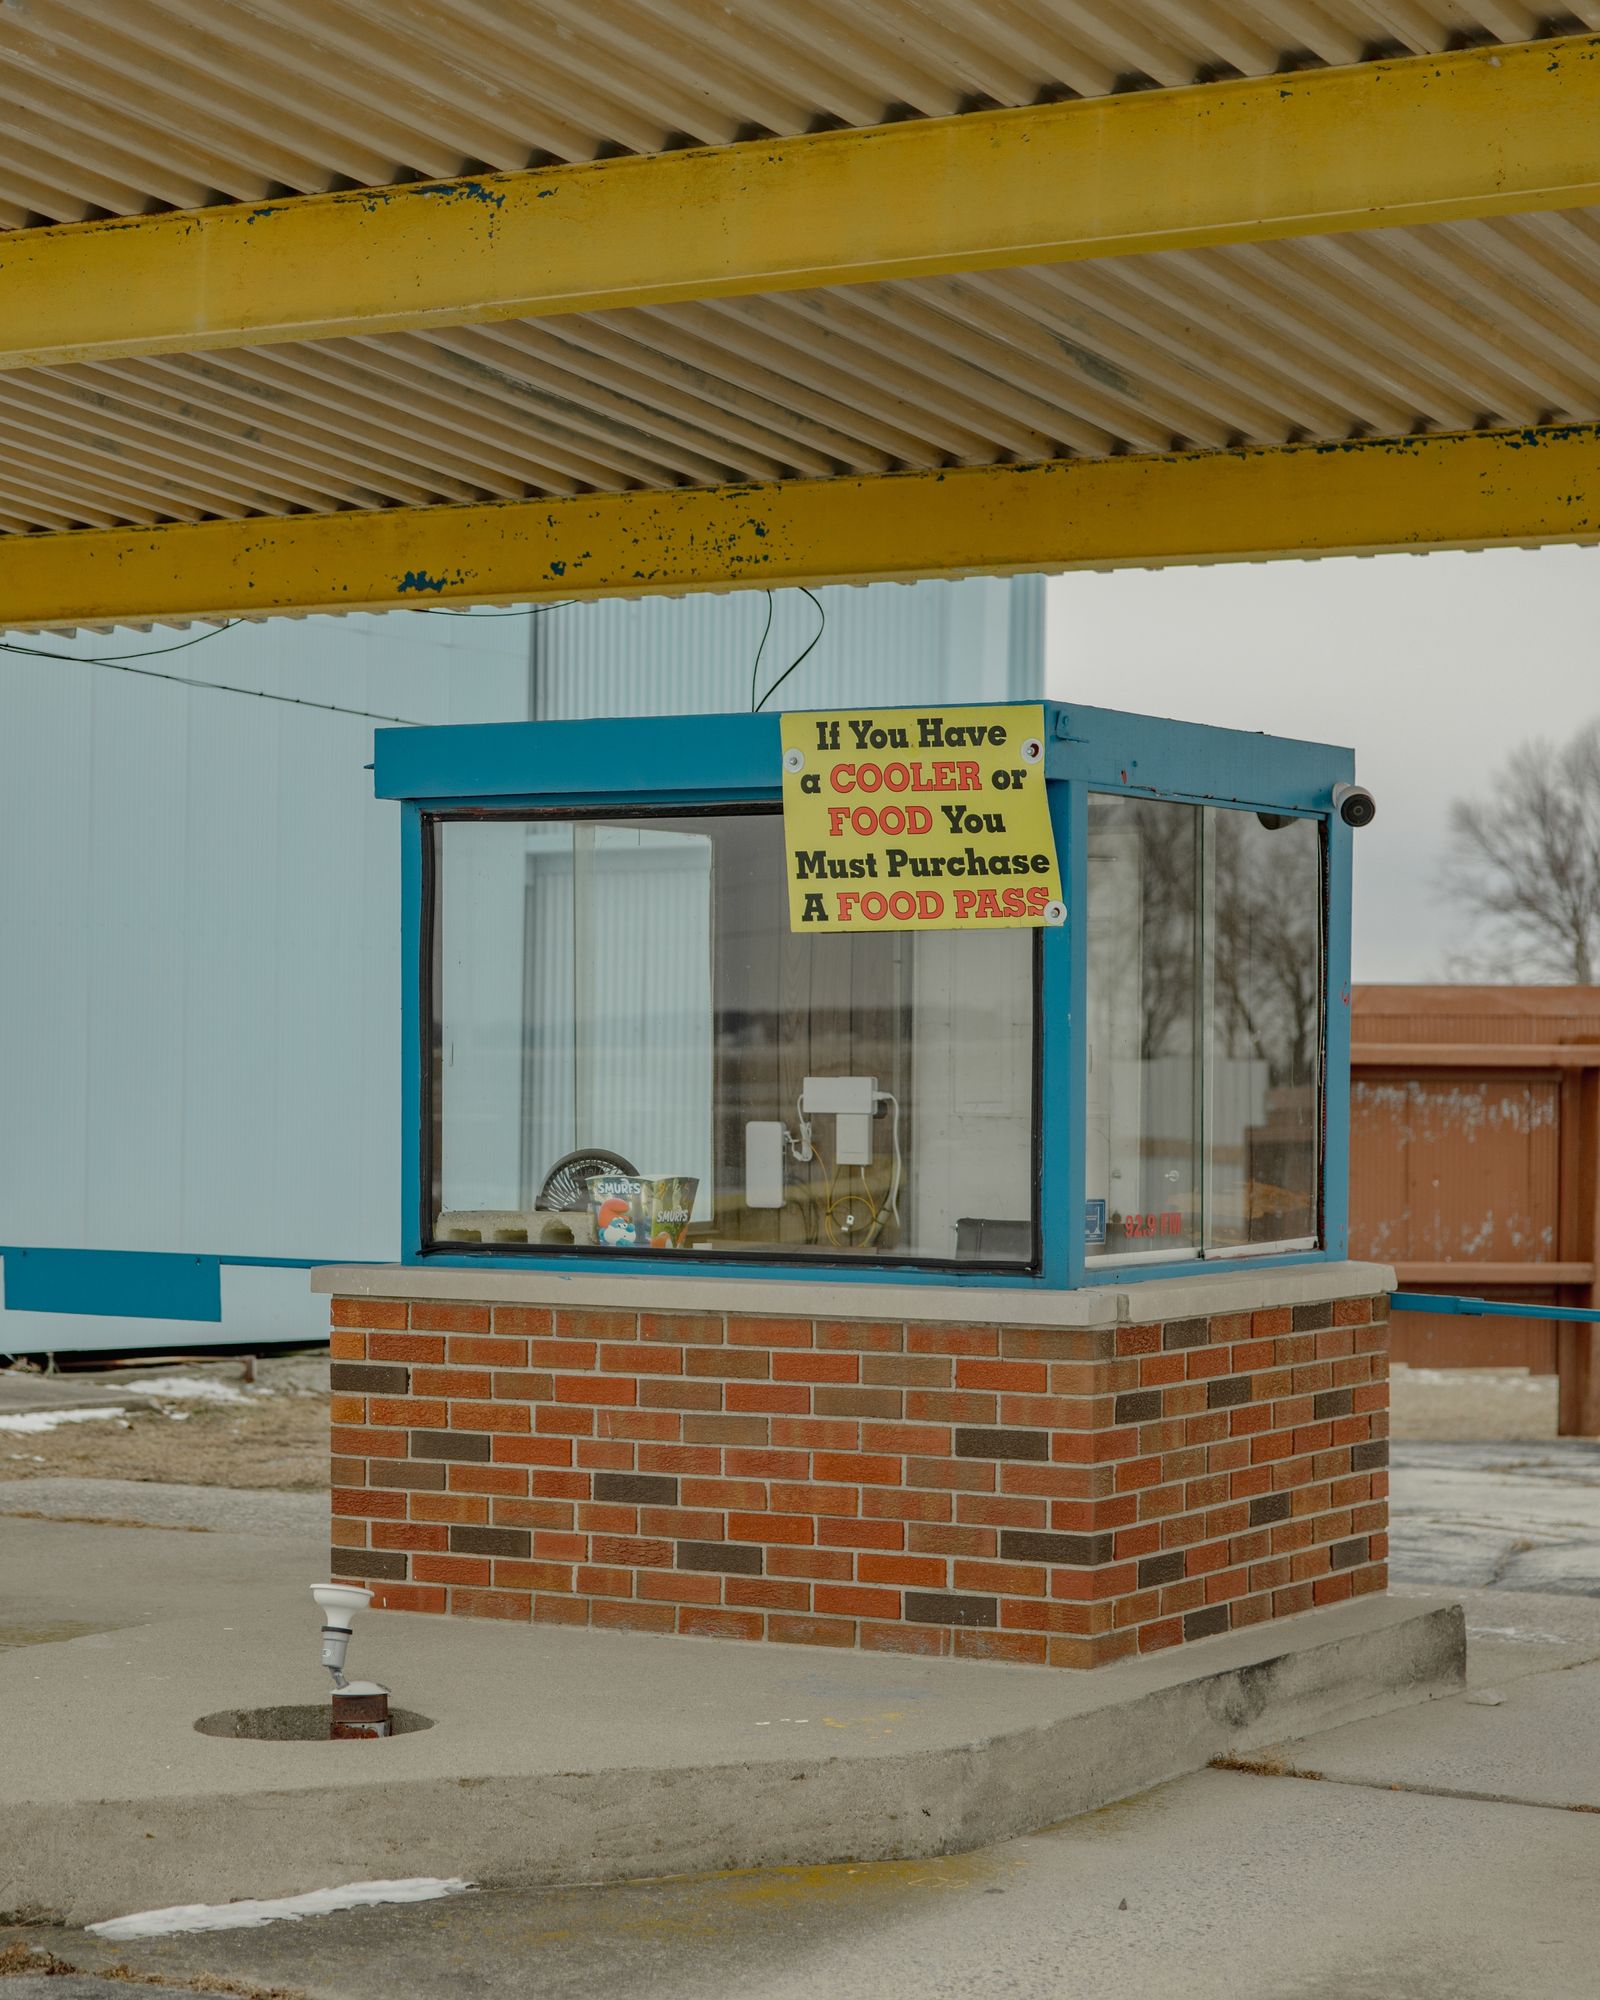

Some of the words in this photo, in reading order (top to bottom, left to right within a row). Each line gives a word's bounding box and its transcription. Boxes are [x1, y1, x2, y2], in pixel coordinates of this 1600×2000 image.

[816, 721, 840, 750] If
[849, 720, 909, 749] You
[917, 718, 1007, 748] Have
[801, 774, 821, 794] a
[830, 761, 982, 793] COOLER
[992, 769, 1027, 790] or
[828, 806, 932, 836] FOOD
[941, 805, 1006, 834] You
[795, 850, 878, 879] Must
[886, 848, 1050, 878] Purchase
[802, 893, 828, 921] A
[837, 890, 944, 920] FOOD
[953, 887, 1049, 918] PASS
[597, 1180, 641, 1194] SMURFS
[656, 1207, 688, 1222] SMURFS
[1125, 1213, 1156, 1239] 92.9
[1160, 1212, 1182, 1237] FM
